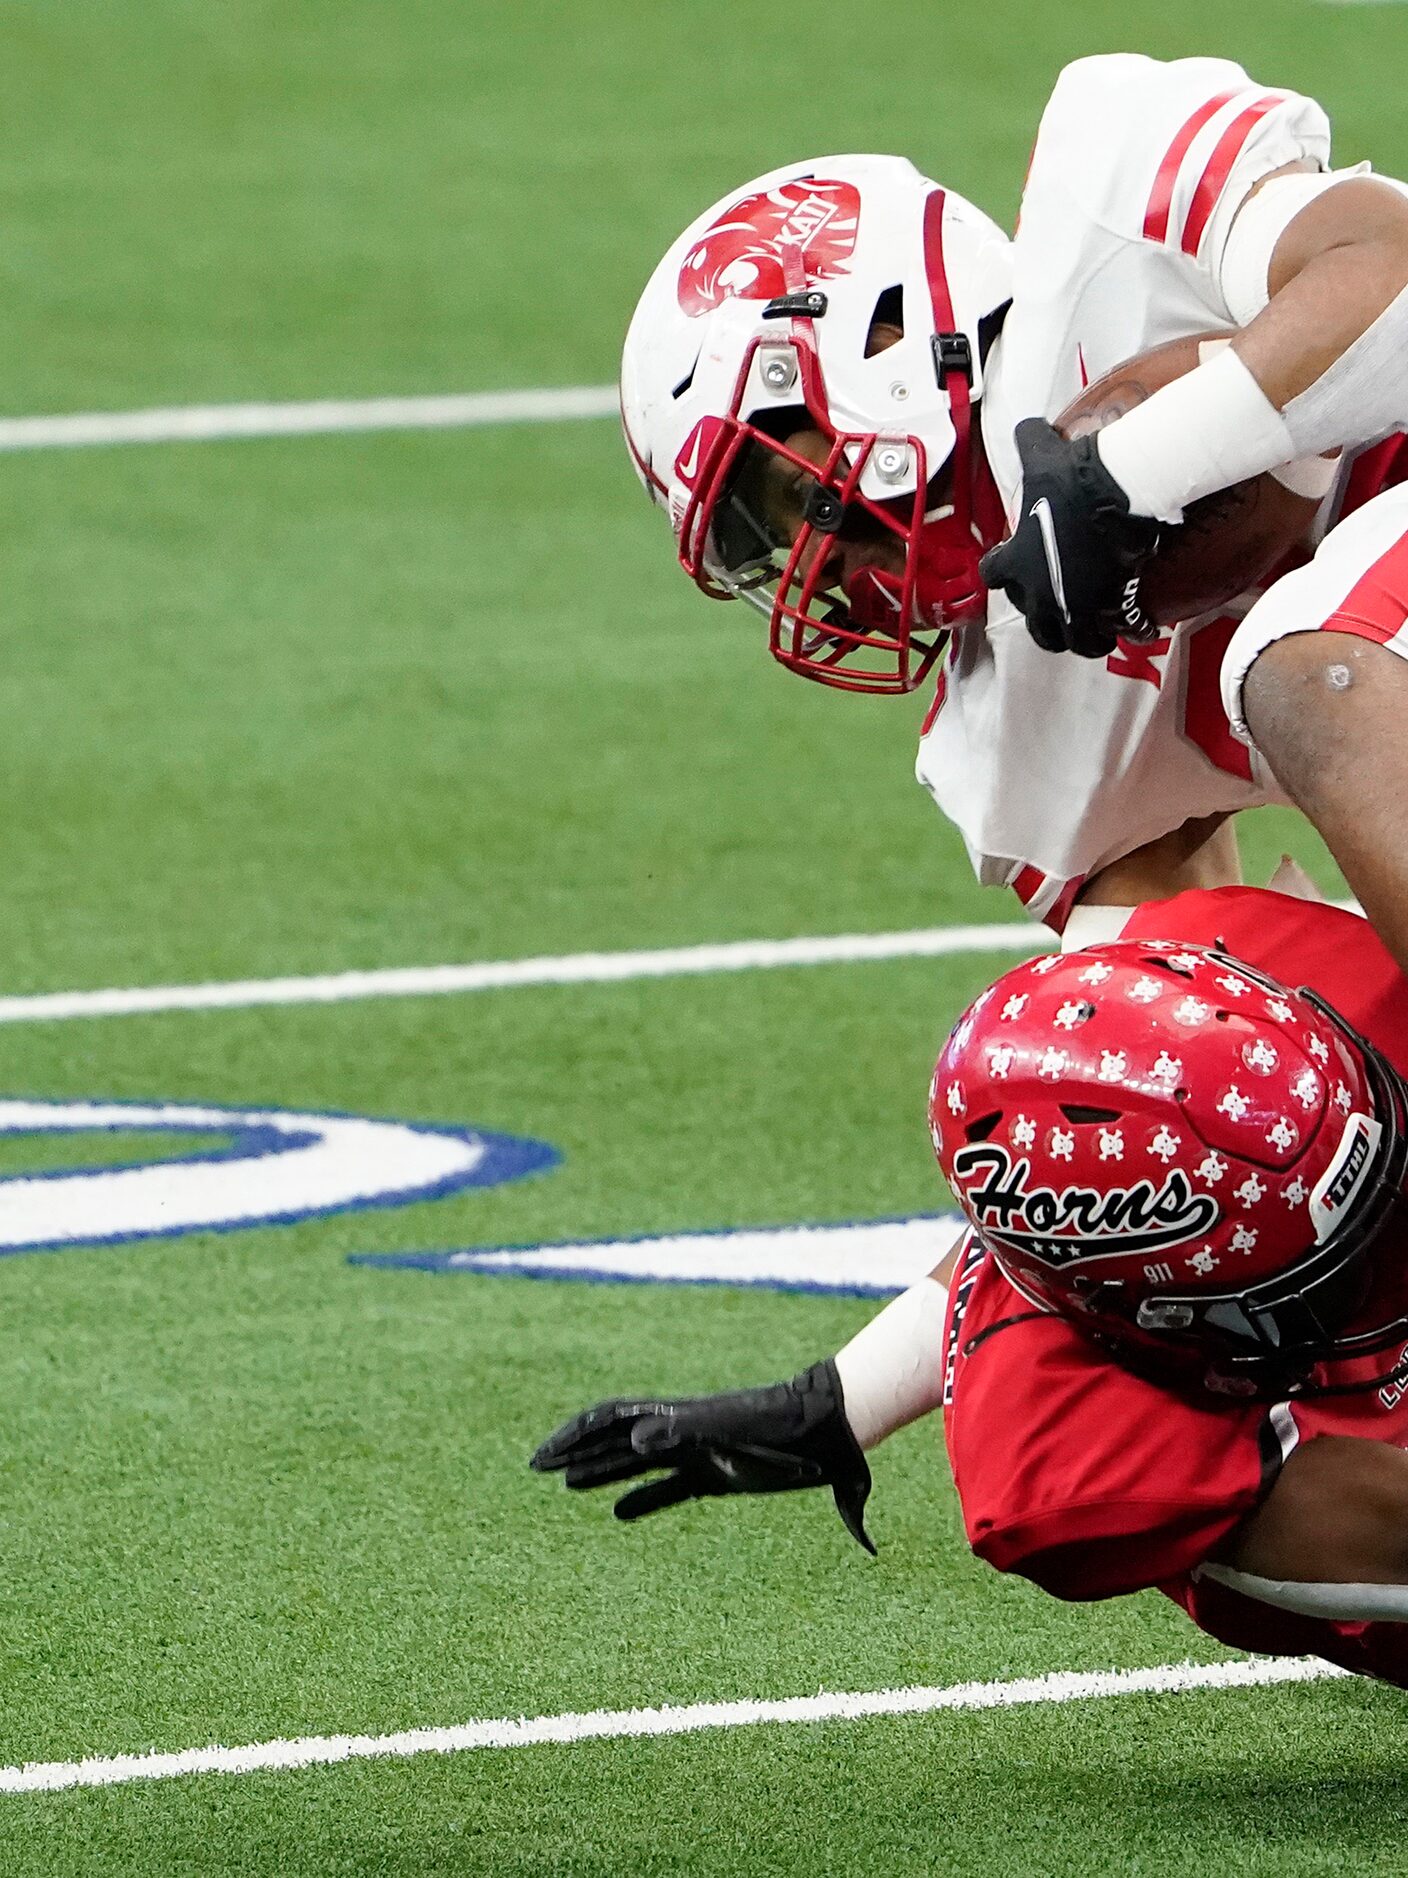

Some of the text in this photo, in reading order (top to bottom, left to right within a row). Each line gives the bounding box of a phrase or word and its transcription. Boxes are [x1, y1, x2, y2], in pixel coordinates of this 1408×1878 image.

[773, 192, 839, 253] KATY
[954, 1143, 1208, 1236] Horns
[1143, 1262, 1174, 1284] 911
